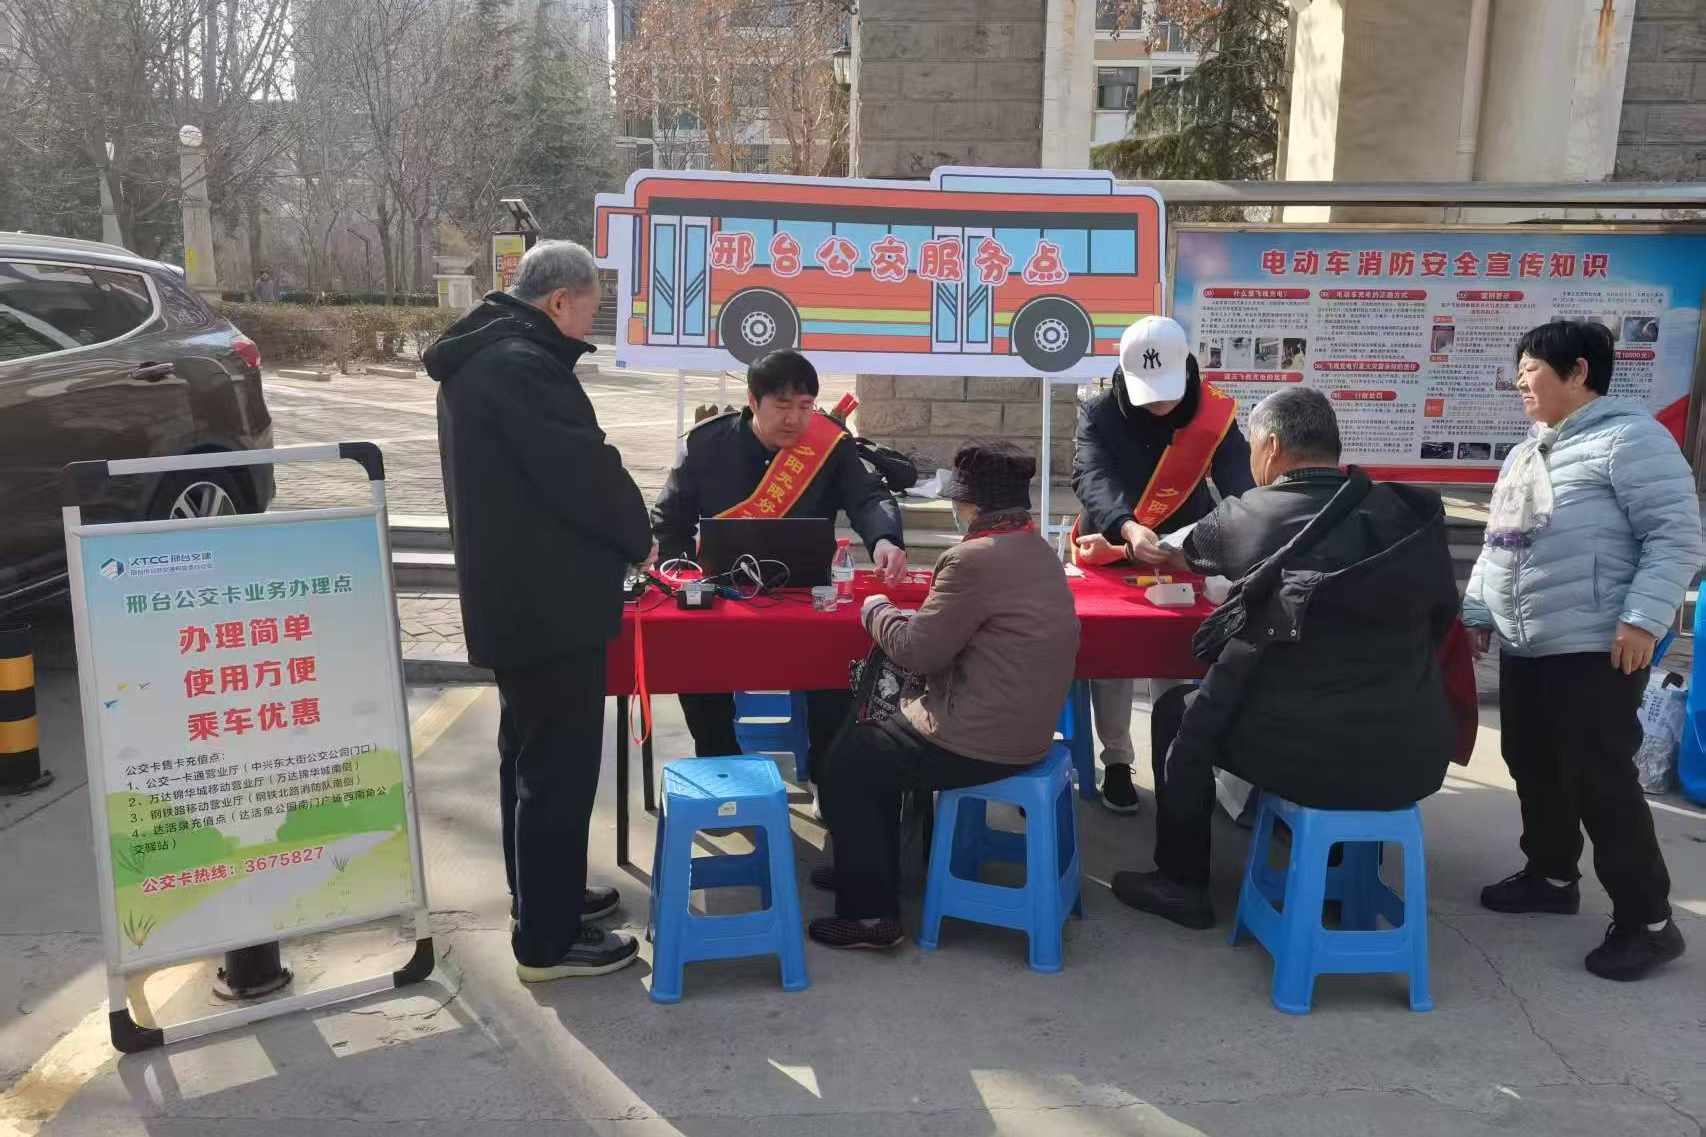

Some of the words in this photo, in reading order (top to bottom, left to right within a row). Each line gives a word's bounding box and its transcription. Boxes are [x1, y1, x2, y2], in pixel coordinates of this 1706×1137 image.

[711, 231, 1067, 285] 邢台公交服务点
[1261, 249, 1609, 280] 电动车消防安全宣传知识
[741, 445, 817, 518] 夕阳无限好
[126, 575, 353, 614] 邢台公交卡业务办理点
[178, 612, 313, 655] 办理简单
[183, 655, 318, 699] 使用方便
[187, 698, 322, 742] 乘车优惠
